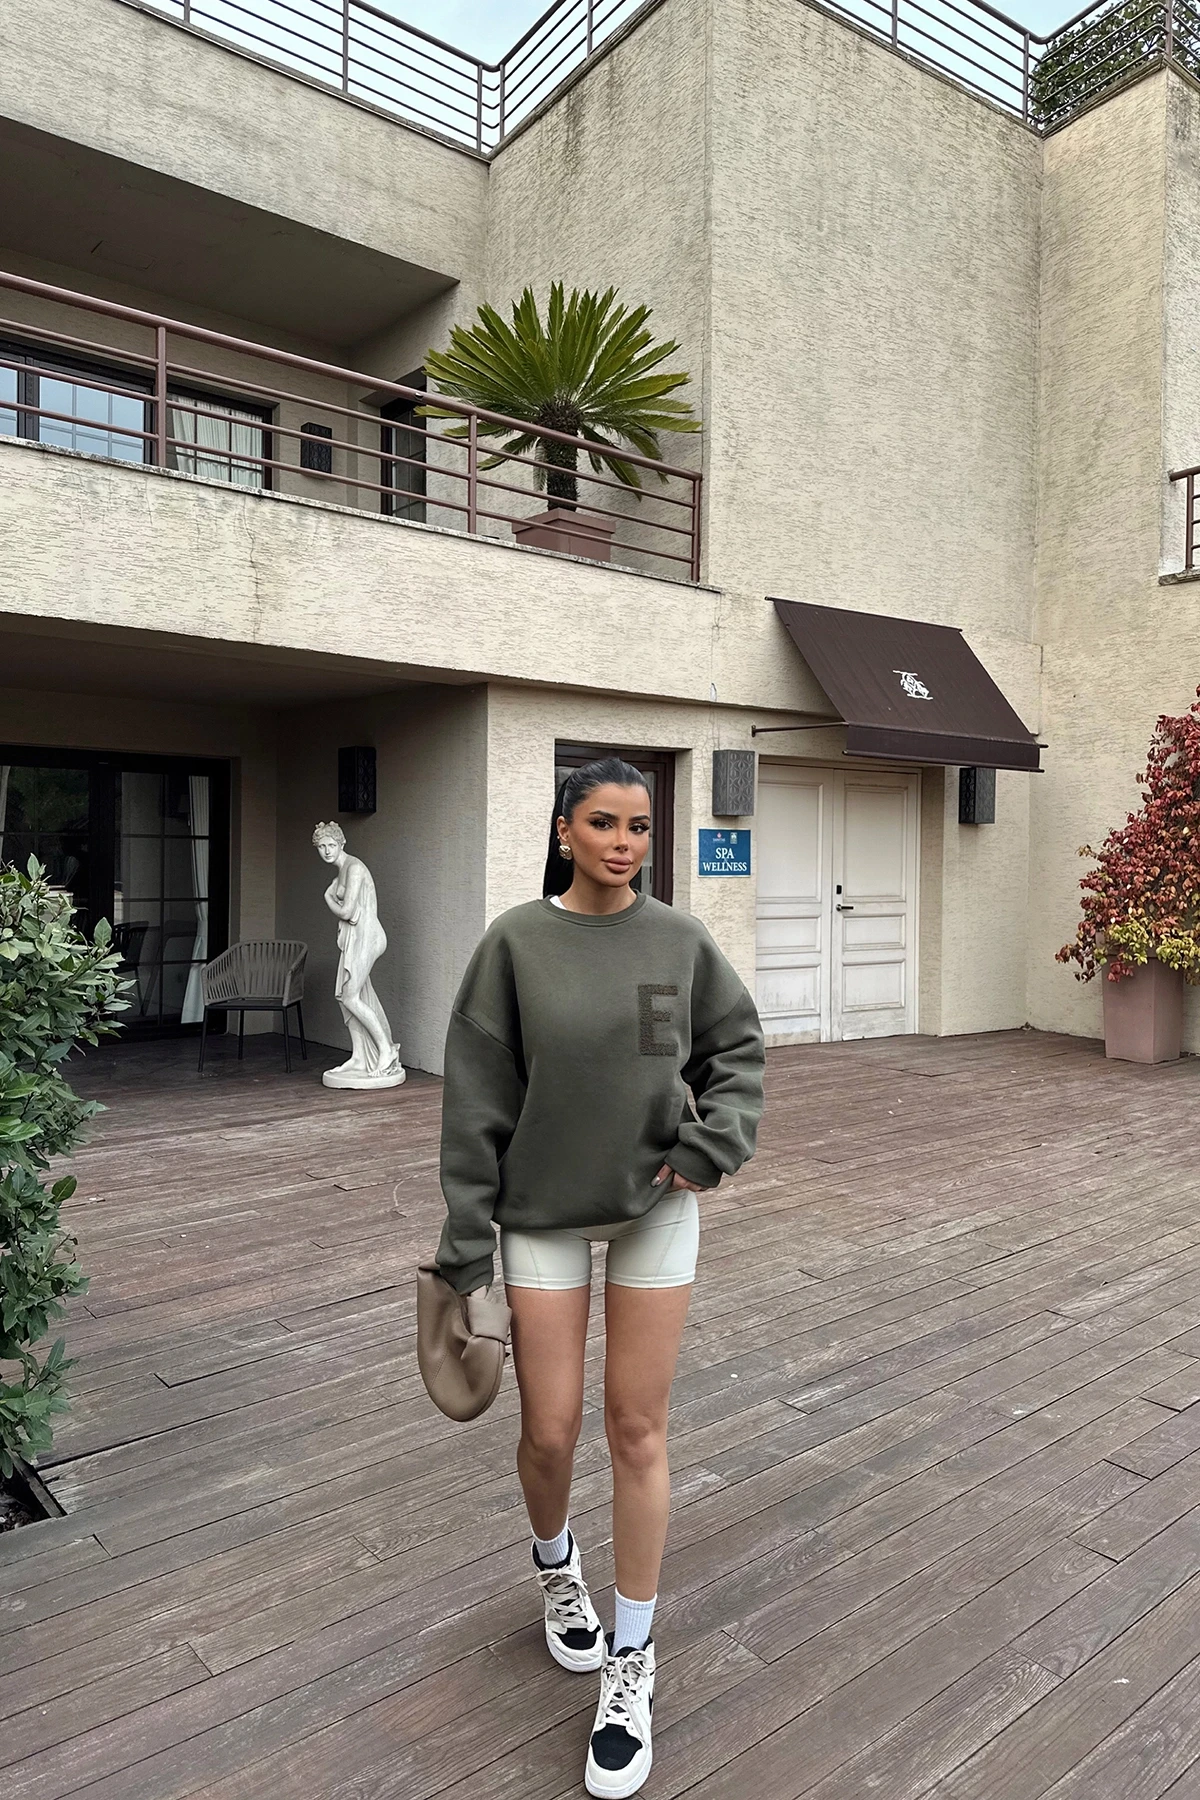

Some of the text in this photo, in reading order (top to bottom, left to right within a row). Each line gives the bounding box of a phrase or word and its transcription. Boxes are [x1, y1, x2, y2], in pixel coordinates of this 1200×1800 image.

[715, 847, 735, 859] SPA
[702, 861, 748, 872] WELLNESS
[637, 984, 679, 1056] E
